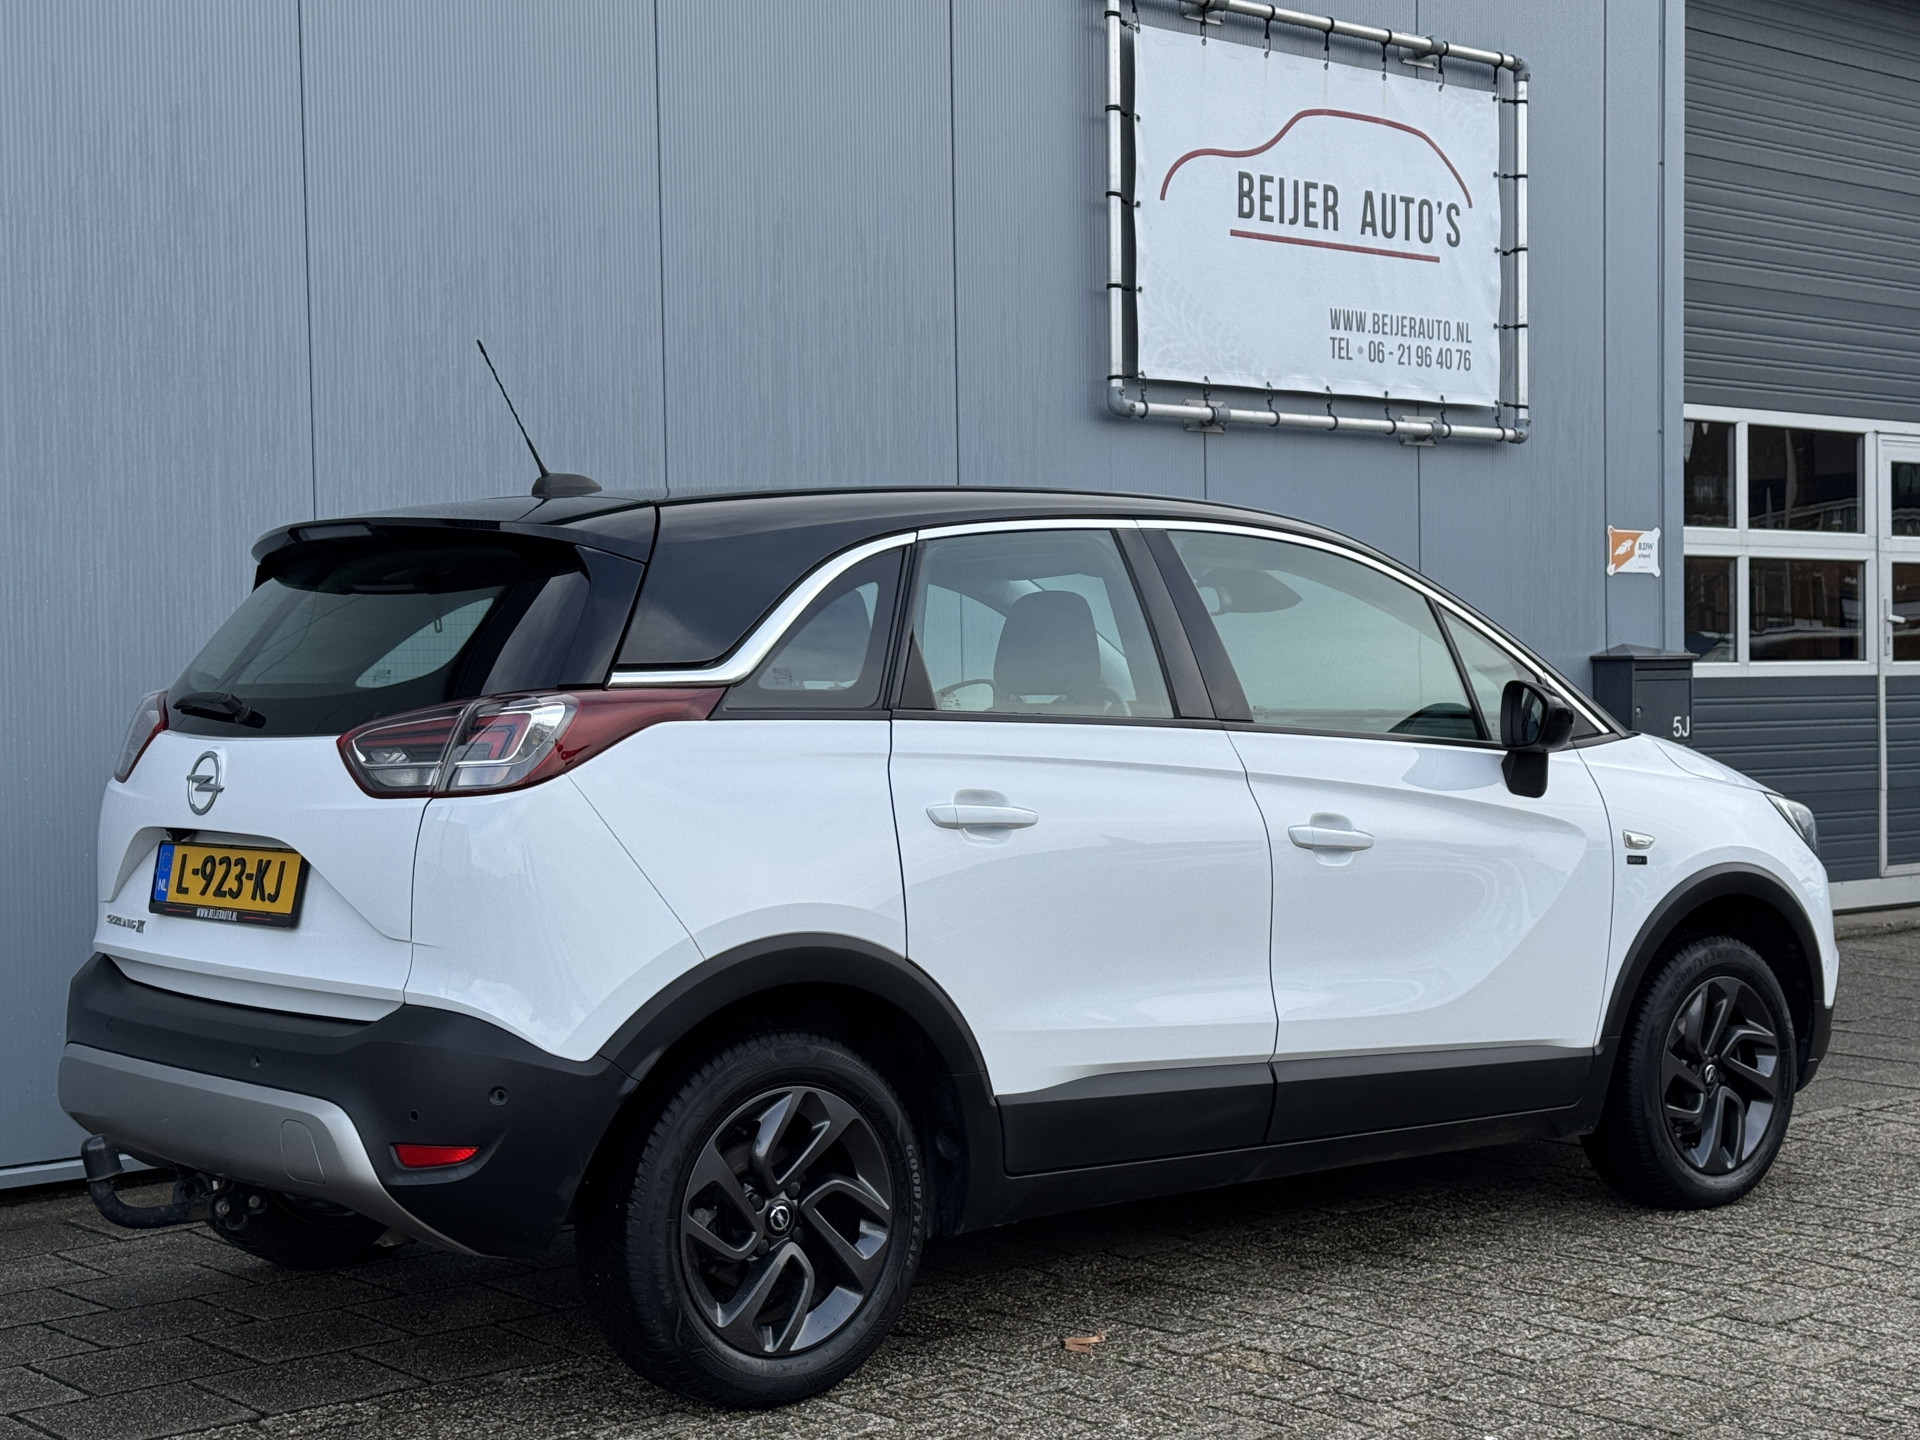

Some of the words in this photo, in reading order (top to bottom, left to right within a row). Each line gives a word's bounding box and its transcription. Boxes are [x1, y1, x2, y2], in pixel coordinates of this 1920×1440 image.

[1237, 170, 1339, 231] BEIJER
[1360, 189, 1461, 248] AUTO'S
[1329, 307, 1472, 344] WWW.BEIJERAUTO.NL
[1329, 336, 1353, 361] TEL
[1368, 340, 1385, 364] 06
[1397, 343, 1412, 366] 21
[1415, 345, 1432, 368] 96
[1435, 347, 1452, 370] 40
[1455, 349, 1471, 371] 76
[1673, 715, 1690, 737] 5J
[157, 878, 167, 891] NL
[176, 853, 286, 904] L-923-KJ
[905, 1143, 922, 1268] GOODYEAR
